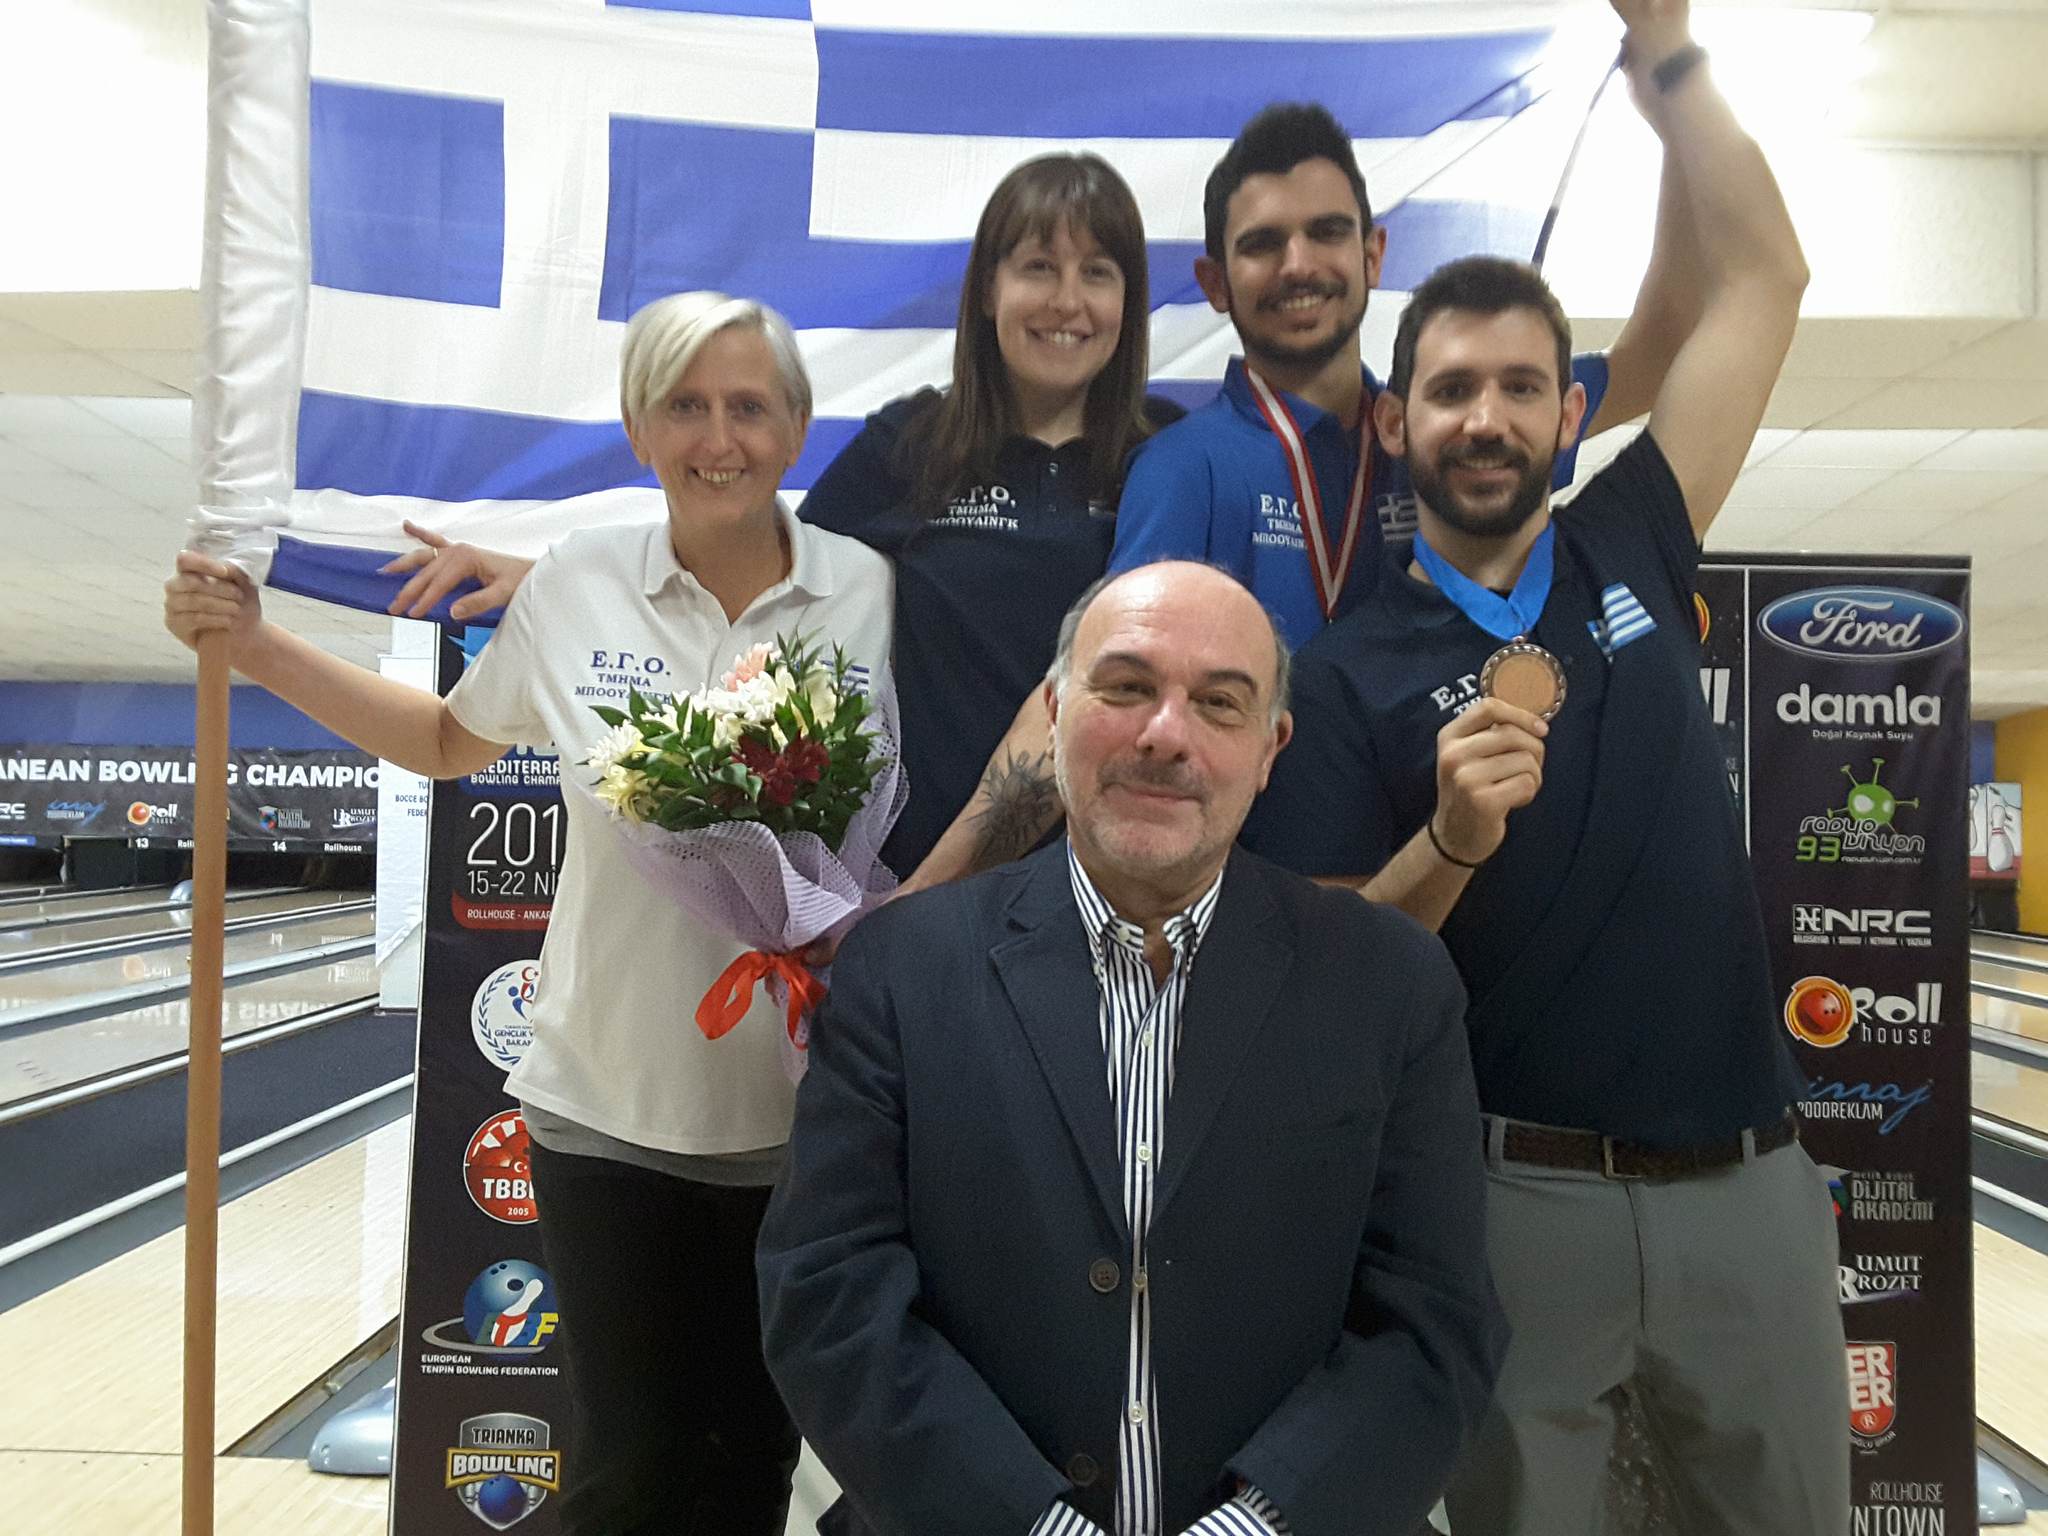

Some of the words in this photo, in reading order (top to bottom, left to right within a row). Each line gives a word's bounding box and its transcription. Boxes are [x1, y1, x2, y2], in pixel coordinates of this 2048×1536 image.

[951, 485, 1016, 508] .Γ.Ο.
[928, 515, 1019, 531] ΠΟΟΥΛΙΝΓΚ
[1800, 597, 1924, 648] Ford
[1776, 683, 1942, 726] damla
[1846, 730, 1884, 740] Kaynak
[1886, 730, 1914, 742] Suyu
[98, 759, 238, 785] BOWLIG
[470, 773, 519, 785] BOWLING
[135, 837, 149, 849] 13
[272, 841, 288, 853] 14
[323, 842, 363, 852] Rollhouse
[1796, 836, 1841, 862] 93
[466, 869, 526, 896] 15-22
[466, 908, 516, 920] ROLLHOUSE
[1824, 907, 1932, 934] NRC
[1852, 982, 1943, 1025] Roll
[1861, 1021, 1932, 1045] house
[507, 1206, 530, 1217] 2005
[1855, 1254, 1924, 1272] UMUT
[1857, 1274, 1924, 1291] ROZET
[421, 1353, 472, 1364] EUROPEAN
[421, 1364, 455, 1375] TENPIN
[456, 1365, 499, 1376] BOWLING
[500, 1366, 559, 1376] FEDERATION
[471, 1426, 537, 1445] TRIANKA
[452, 1453, 554, 1480] BOWLING
